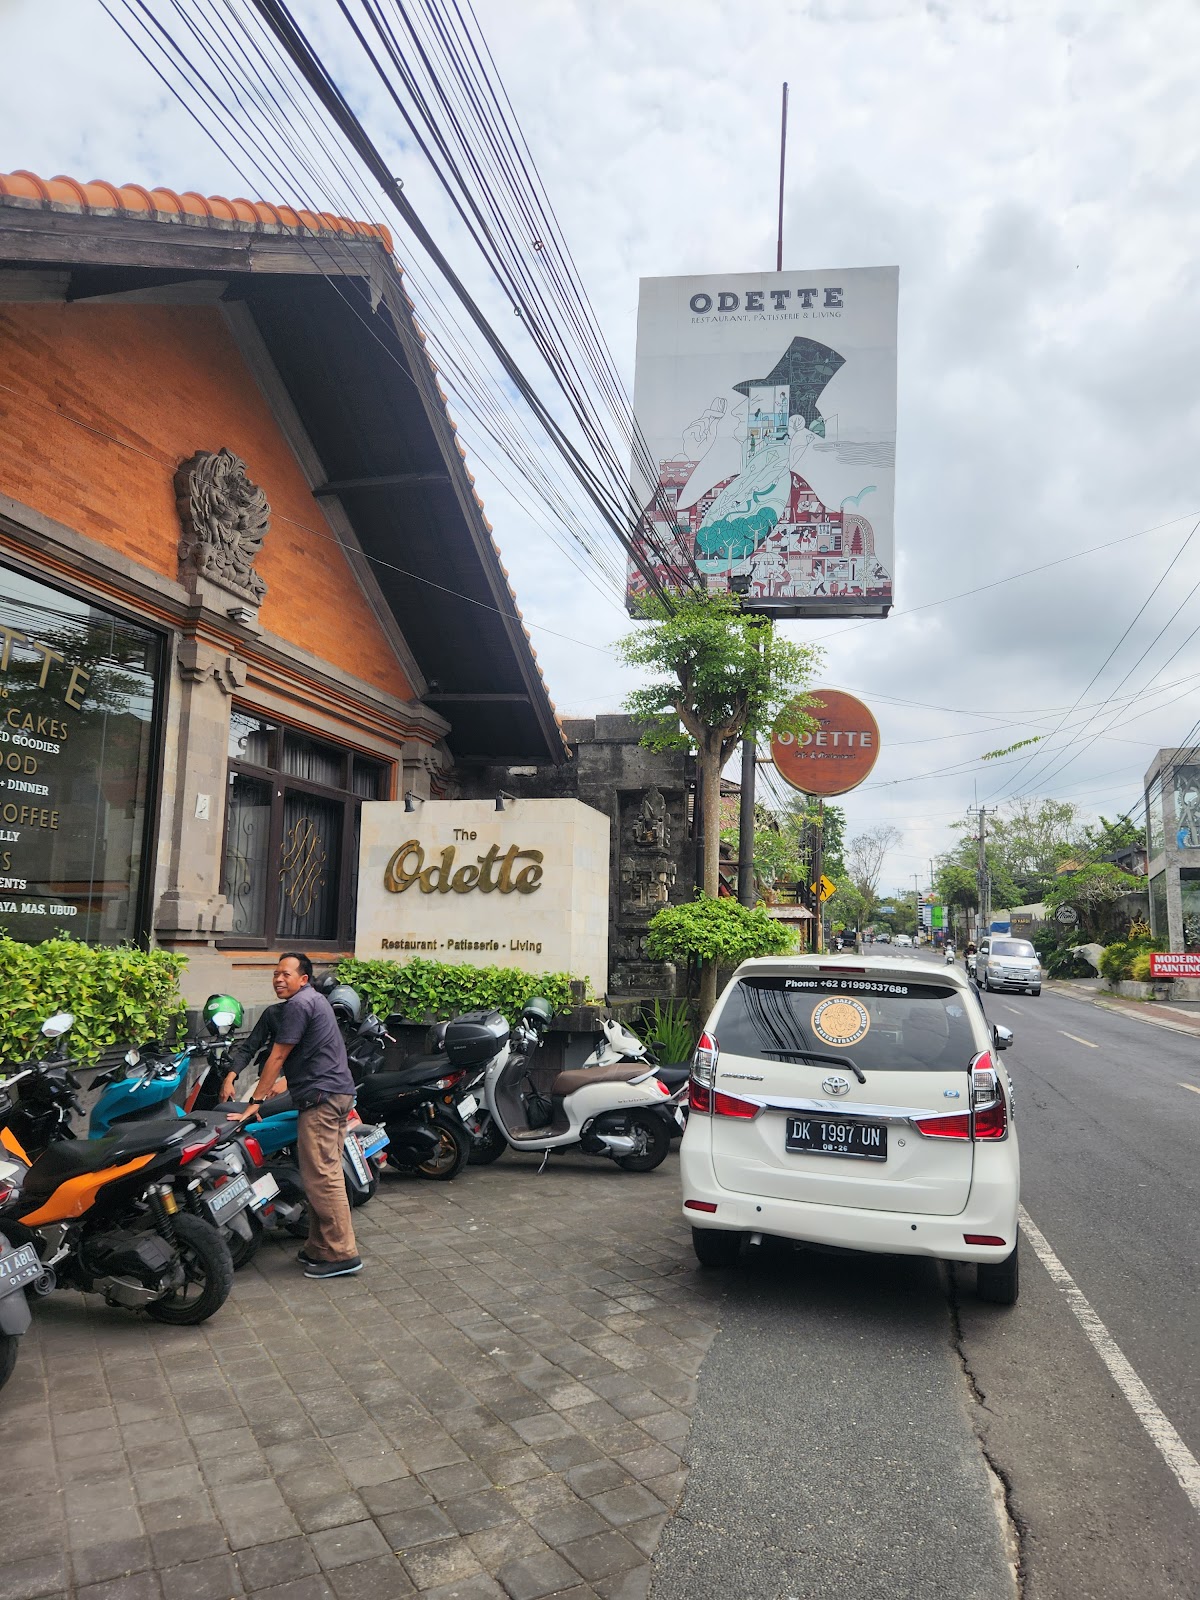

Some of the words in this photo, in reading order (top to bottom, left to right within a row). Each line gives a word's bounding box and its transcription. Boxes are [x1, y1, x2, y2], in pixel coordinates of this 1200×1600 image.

[689, 287, 844, 314] ODETTE
[812, 311, 842, 319] LIVING
[7, 708, 68, 740] CAKES
[12, 734, 60, 754] GOODIES
[777, 730, 872, 747] ODETTE
[0, 751, 37, 775] OD
[7, 779, 49, 796] DINNER
[0, 802, 59, 829] OFFEE
[453, 828, 477, 841] The
[384, 839, 544, 894] Odette
[21, 903, 47, 915] MAS,
[49, 904, 77, 916] UBUD
[381, 938, 437, 950] Restaurant
[447, 938, 499, 951] Patisserie
[510, 939, 542, 953] Living
[1154, 955, 1200, 963] MODERN
[785, 980, 818, 988] Phone:
[820, 980, 838, 988] +62
[841, 980, 908, 994] 81999337688
[792, 1121, 810, 1140] DK
[821, 1124, 855, 1143] 1997
[862, 1127, 880, 1146] UN
[14, 1251, 35, 1269] ABL
